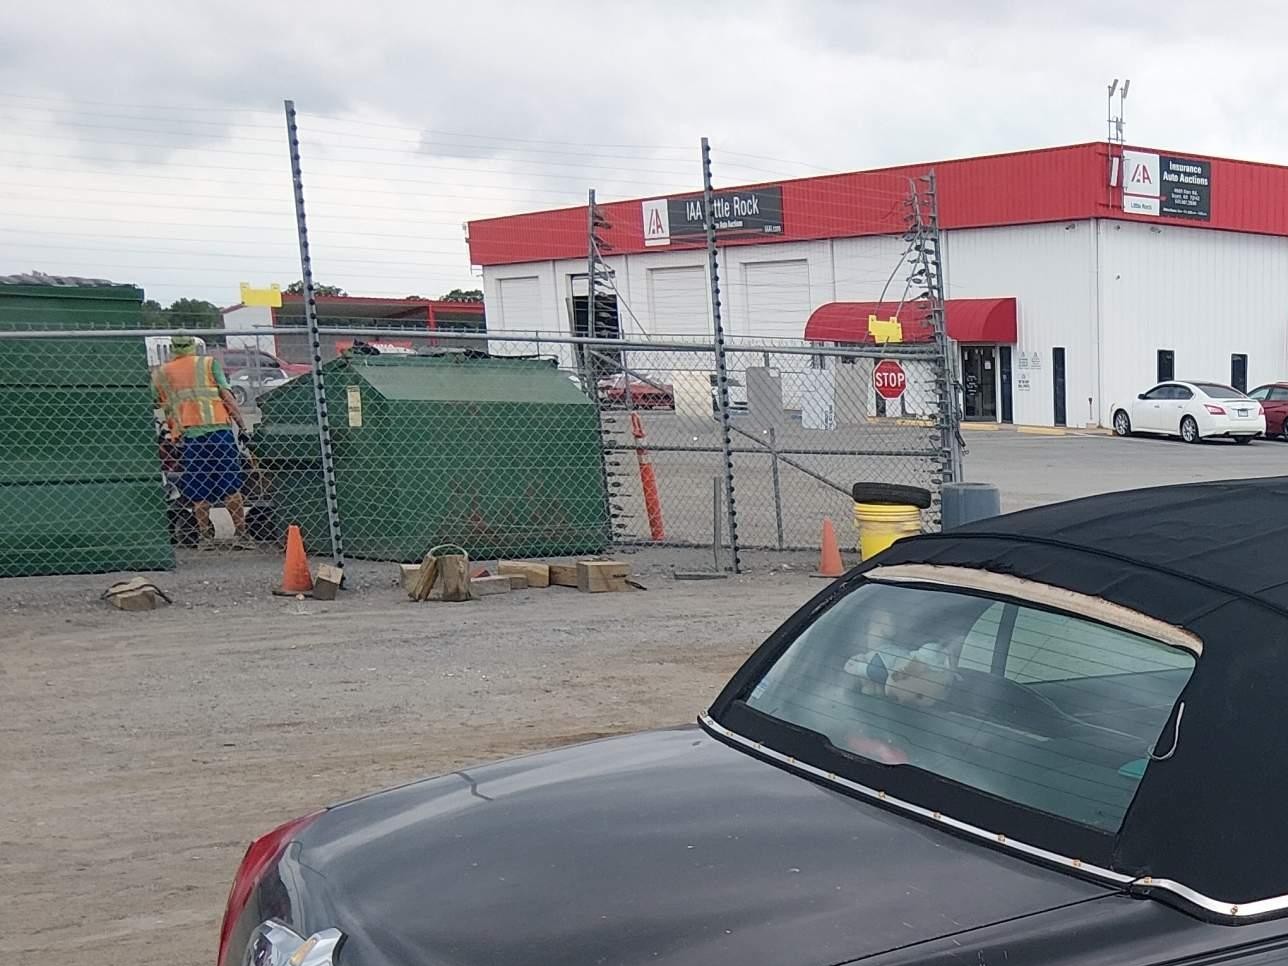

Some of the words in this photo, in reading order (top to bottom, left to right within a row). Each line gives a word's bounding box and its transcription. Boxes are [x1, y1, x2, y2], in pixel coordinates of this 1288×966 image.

[1168, 160, 1202, 174] Insurance
[1162, 170, 1179, 182] Auto
[1179, 174, 1209, 186] Auctions
[686, 200, 703, 222] IAA
[733, 193, 760, 217] Rock
[875, 372, 905, 387] STOP
